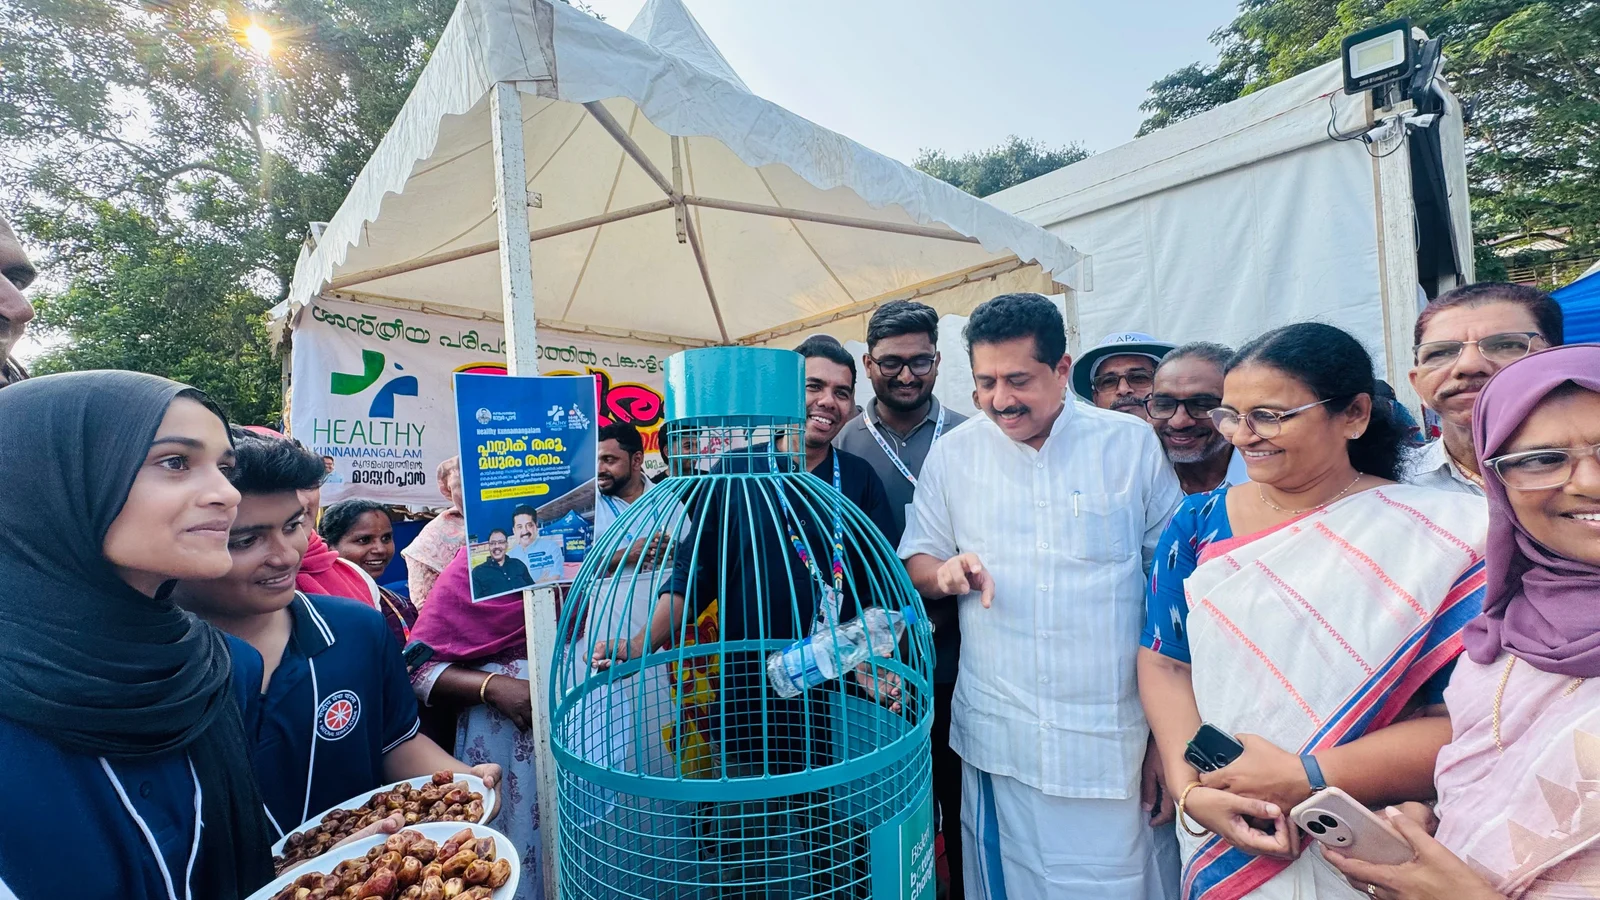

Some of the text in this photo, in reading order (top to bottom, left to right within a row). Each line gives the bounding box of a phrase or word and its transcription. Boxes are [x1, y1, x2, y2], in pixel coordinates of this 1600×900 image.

[313, 418, 425, 447] HEALTHY
[313, 447, 422, 459] KUNNAMANGALAM
[478, 454, 522, 470] മധുരം
